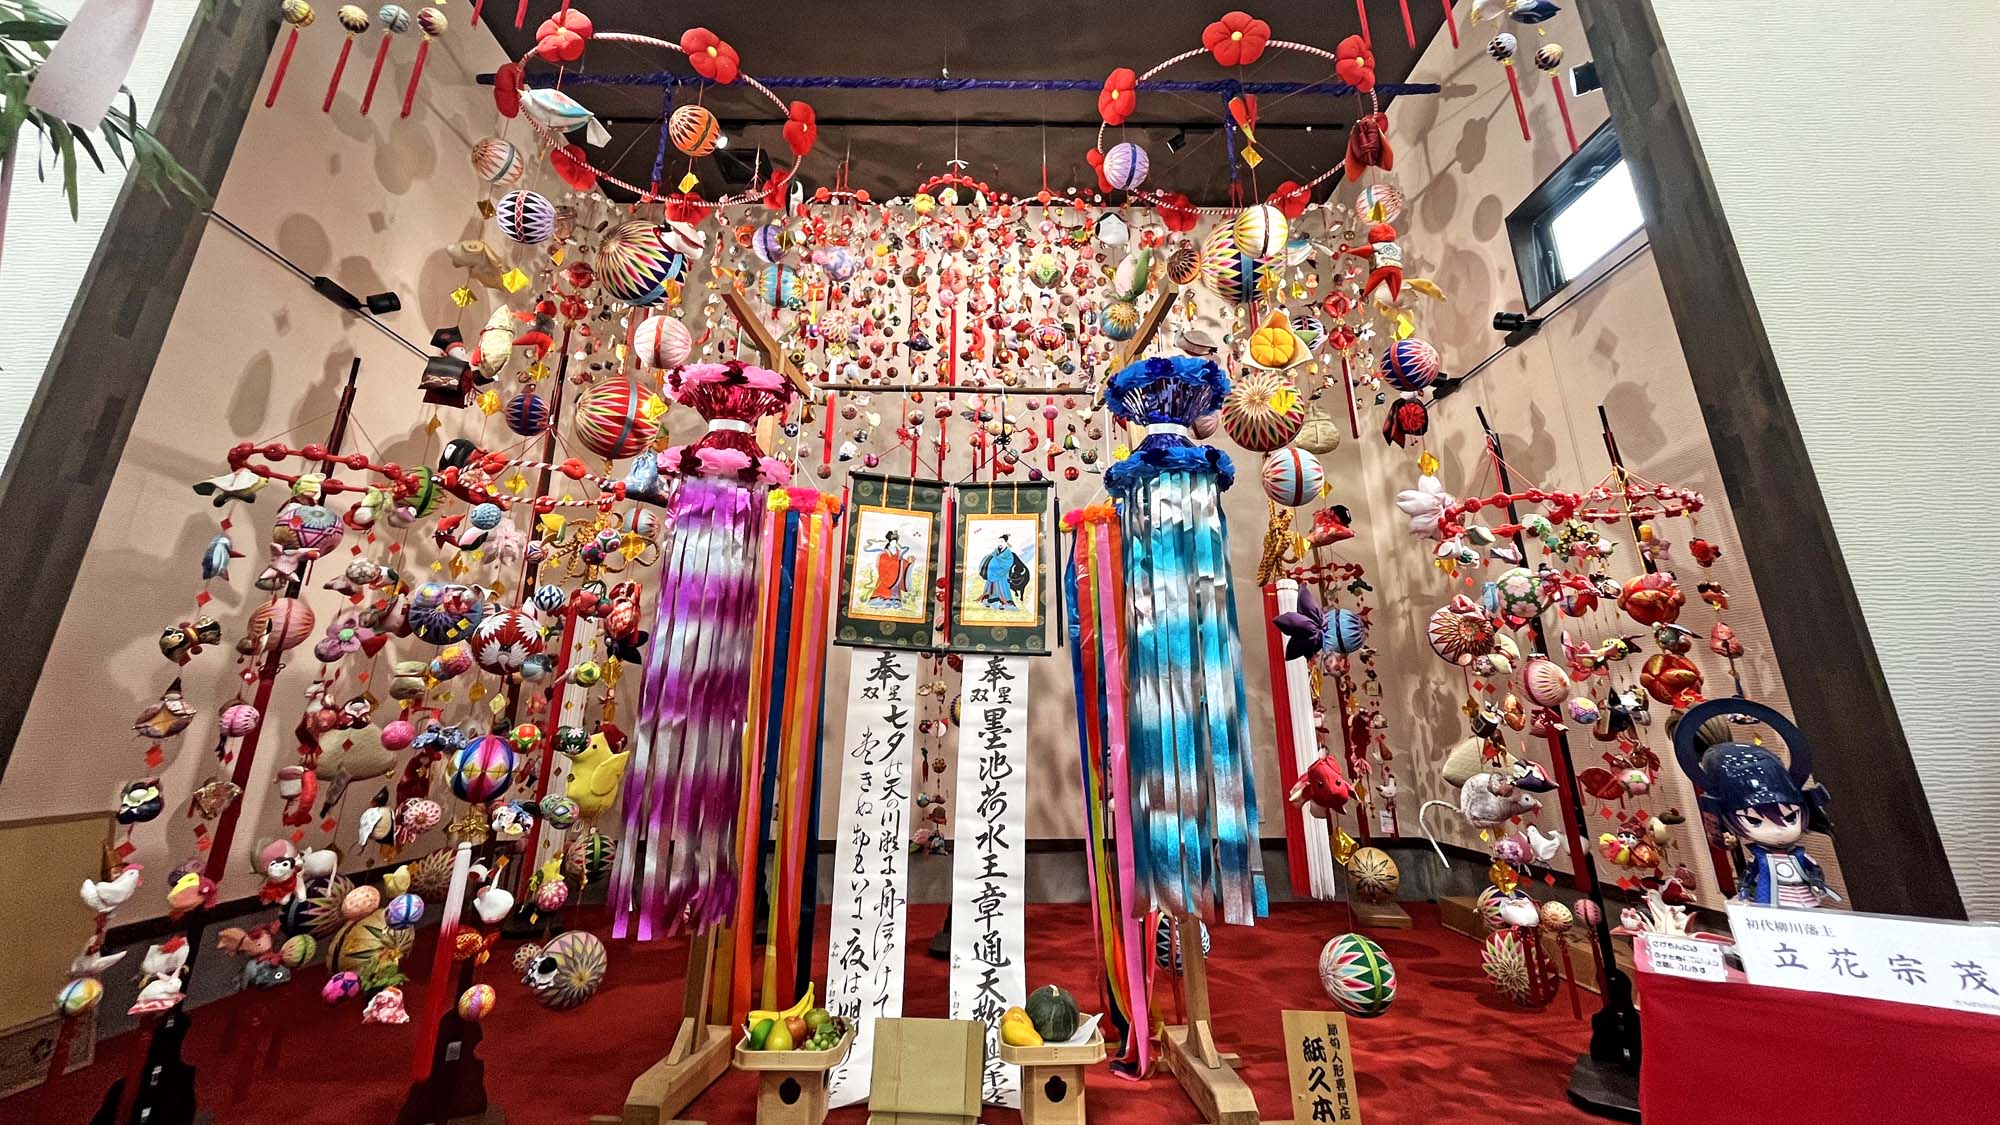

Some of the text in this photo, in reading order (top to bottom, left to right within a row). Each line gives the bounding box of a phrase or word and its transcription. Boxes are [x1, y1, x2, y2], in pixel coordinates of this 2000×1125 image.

[1746, 917, 1836, 938] 初代柳川藩主
[1773, 942, 1999, 996] 立花宗茂
